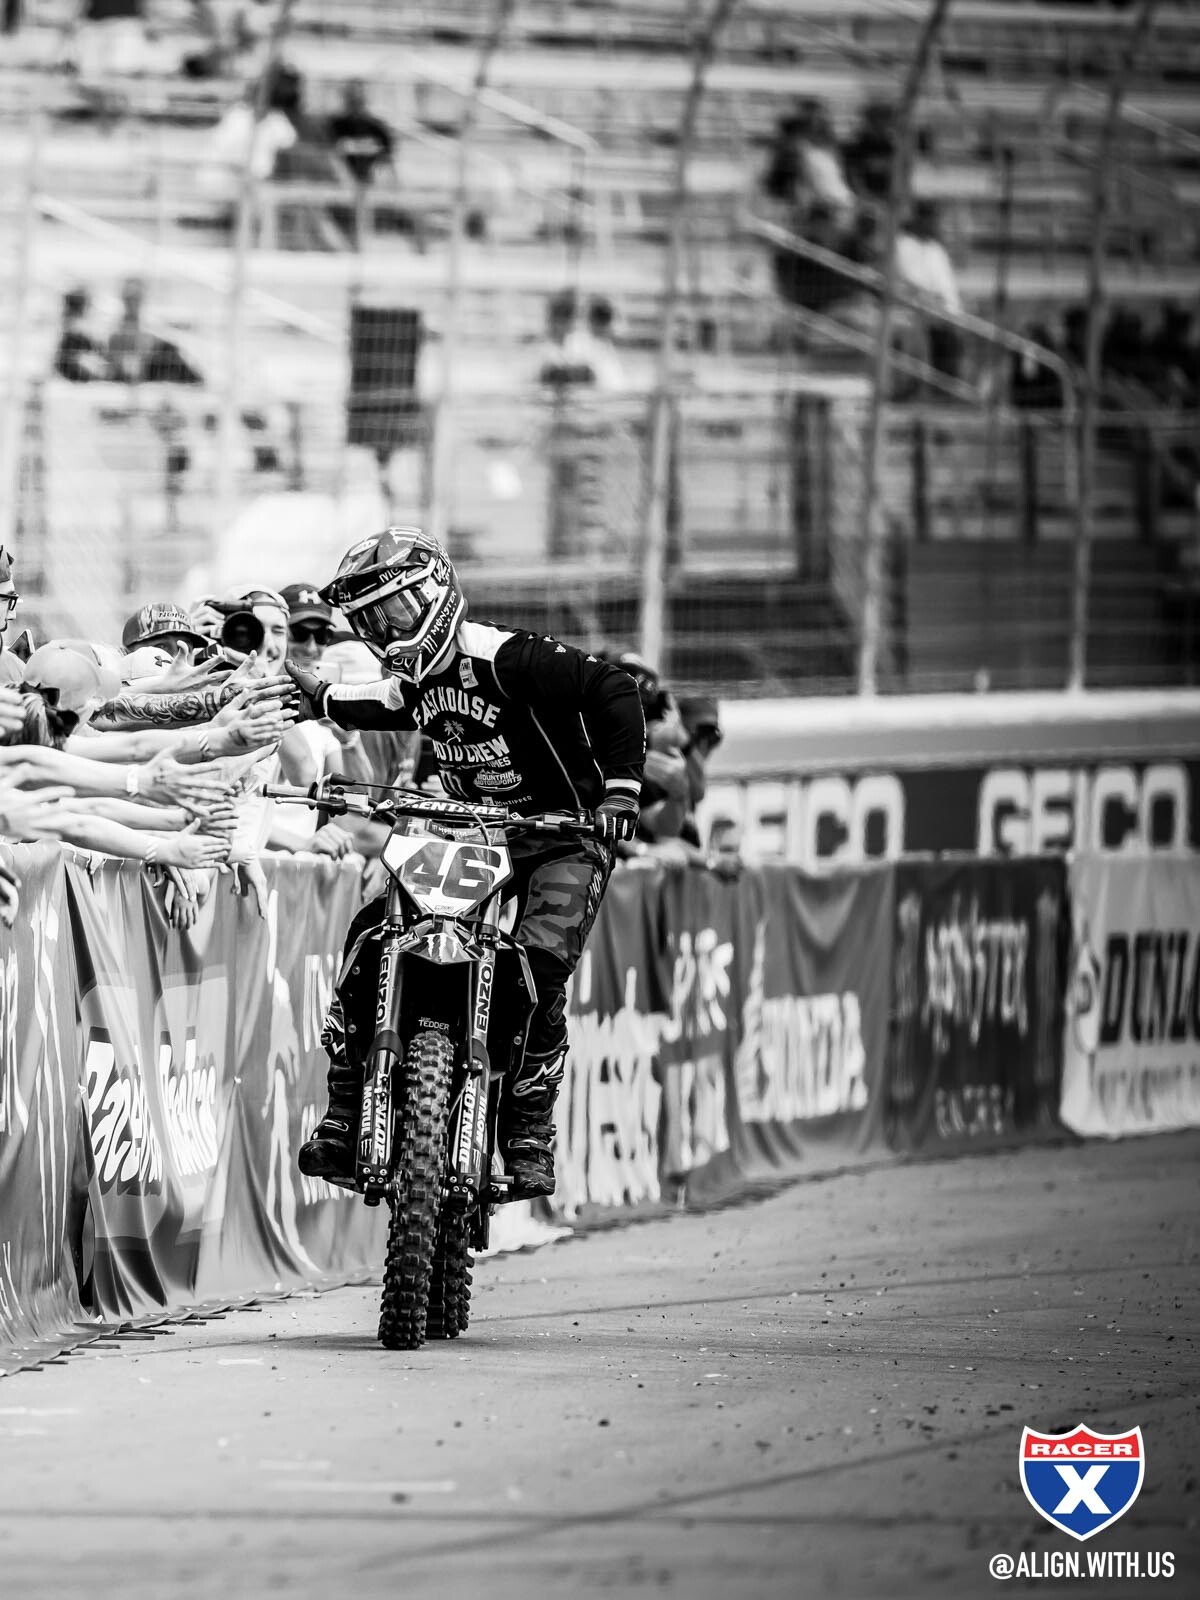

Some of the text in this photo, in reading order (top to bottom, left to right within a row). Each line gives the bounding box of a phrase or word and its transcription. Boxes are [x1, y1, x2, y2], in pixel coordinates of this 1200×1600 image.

[431, 590, 457, 636] MONSTER
[411, 686, 501, 729] FASTHOUSE
[462, 734, 510, 763] CREW
[696, 776, 902, 864] GEICO
[976, 766, 1190, 860] GEICO
[401, 841, 502, 901] 46
[376, 954, 391, 1024] ENZO
[475, 963, 492, 1033] ENZO
[1099, 931, 1200, 1042] DUNL
[418, 1019, 449, 1030] TEDDER
[361, 1086, 373, 1136] MOTUL
[459, 1079, 478, 1165] DUNLOP
[475, 1095, 488, 1148] MOTUL
